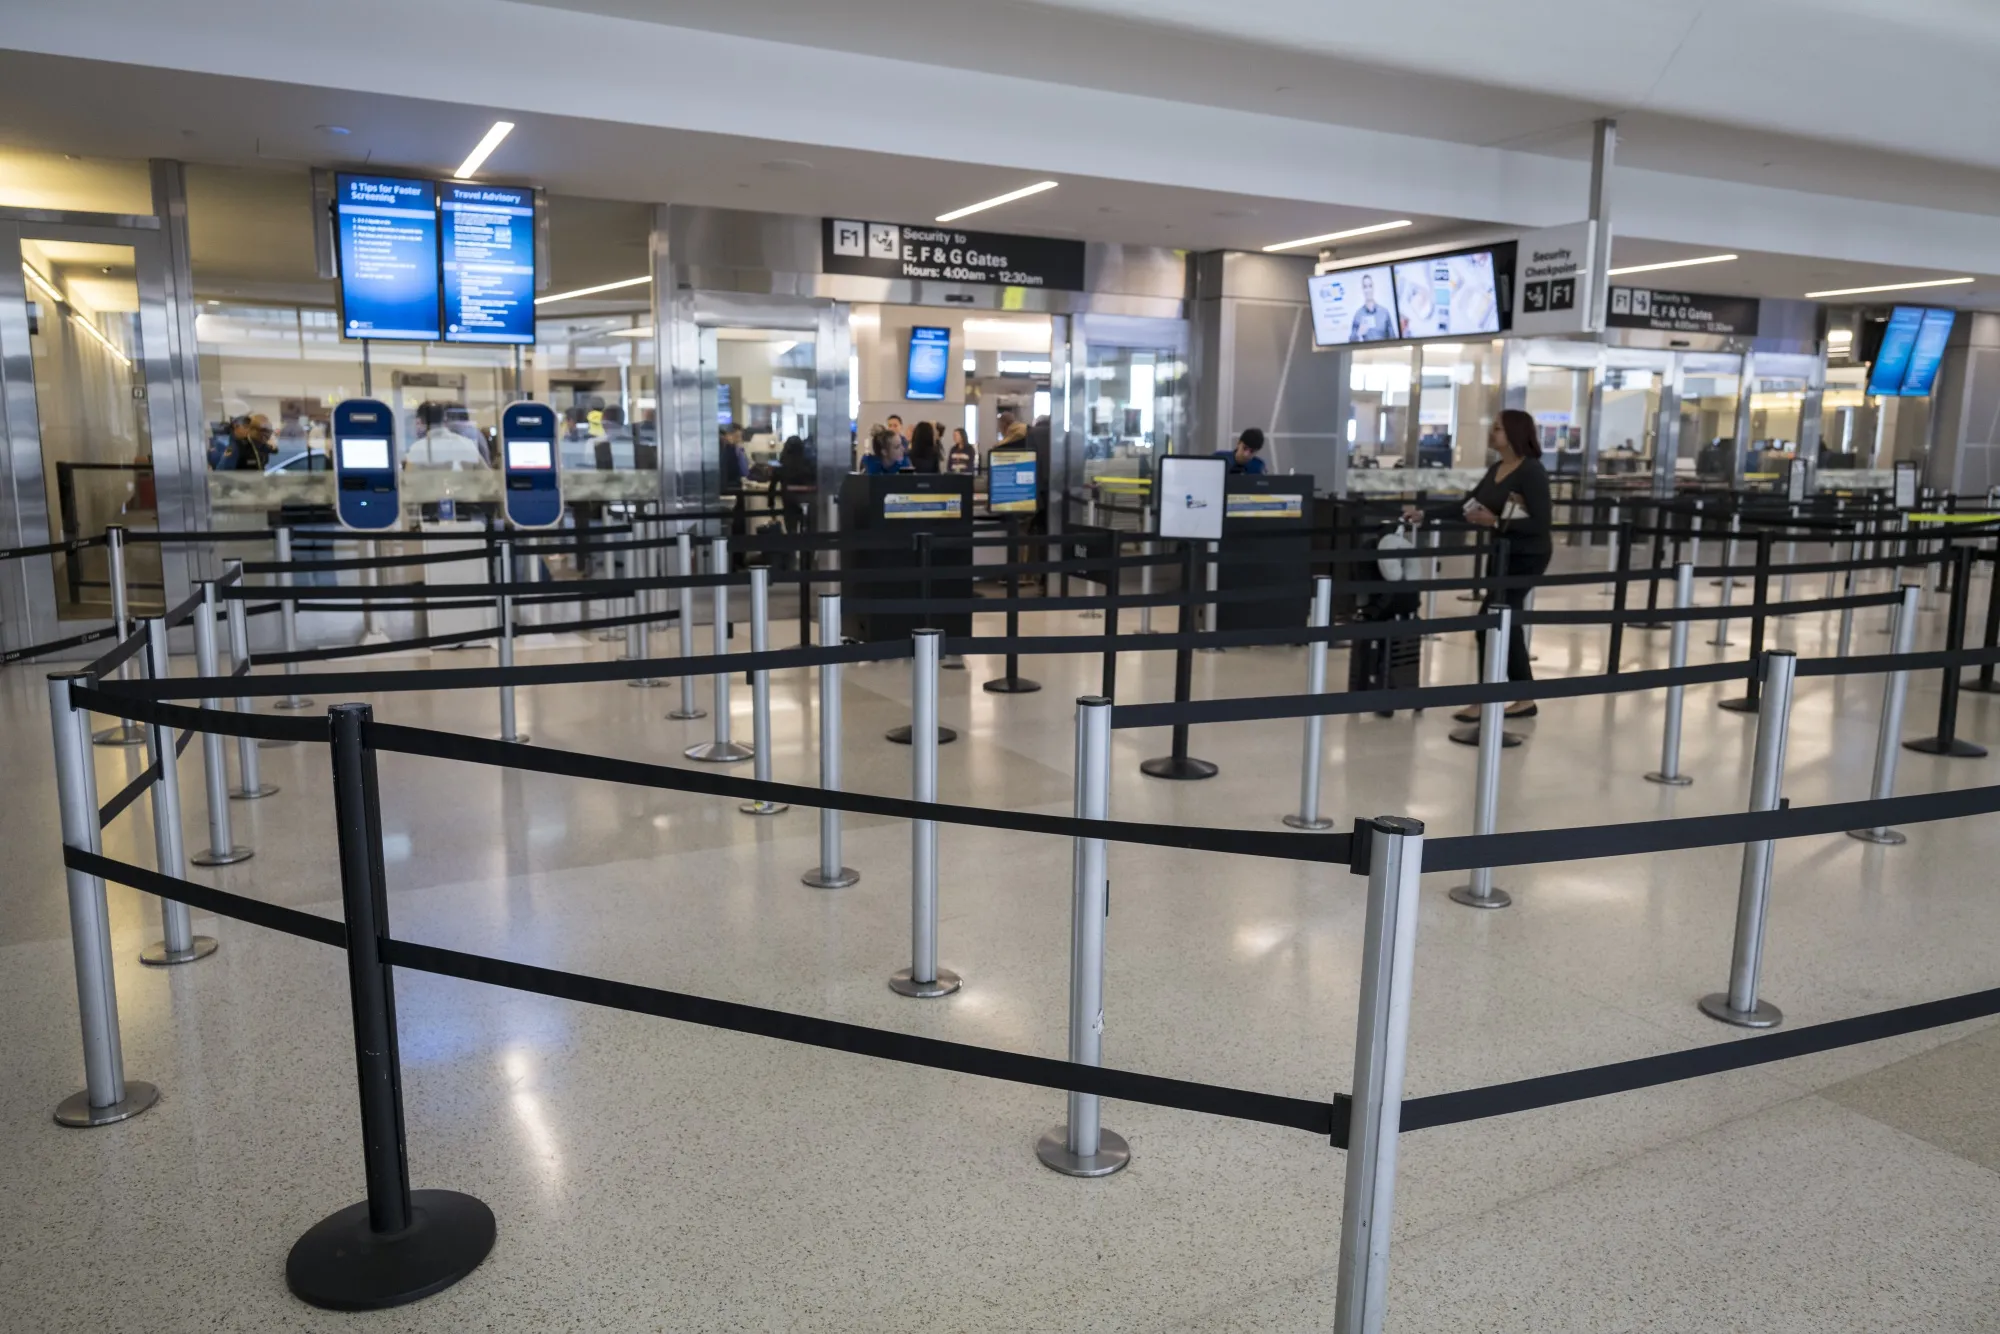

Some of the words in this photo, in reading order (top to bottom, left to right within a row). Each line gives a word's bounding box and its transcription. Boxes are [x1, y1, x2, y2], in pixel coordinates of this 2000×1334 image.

[359, 182, 377, 192] Tips
[379, 184, 393, 193] for
[394, 185, 421, 196] Faster
[351, 191, 396, 204] Screening
[454, 189, 481, 200] Travel
[482, 192, 521, 204] Advisory
[840, 229, 858, 248] F1
[903, 227, 951, 245] Security
[954, 233, 967, 244] to
[903, 245, 917, 263] E,
[921, 246, 931, 262] F
[933, 247, 947, 263] &
[950, 249, 963, 265] G
[966, 250, 1008, 267] Gates
[1533, 248, 1571, 262] Security
[903, 263, 940, 278] Hours:
[943, 266, 986, 280] 4:00am
[999, 271, 1044, 285] 12:30am
[1525, 264, 1577, 277] Checkpoint
[1552, 284, 1571, 304] F1
[1616, 294, 1628, 308] F1
[1653, 292, 1680, 304] Security
[1669, 306, 1677, 318] &
[1678, 307, 1687, 319] G
[1688, 307, 1713, 321] Gates
[6, 652, 20, 660] CLEAR
